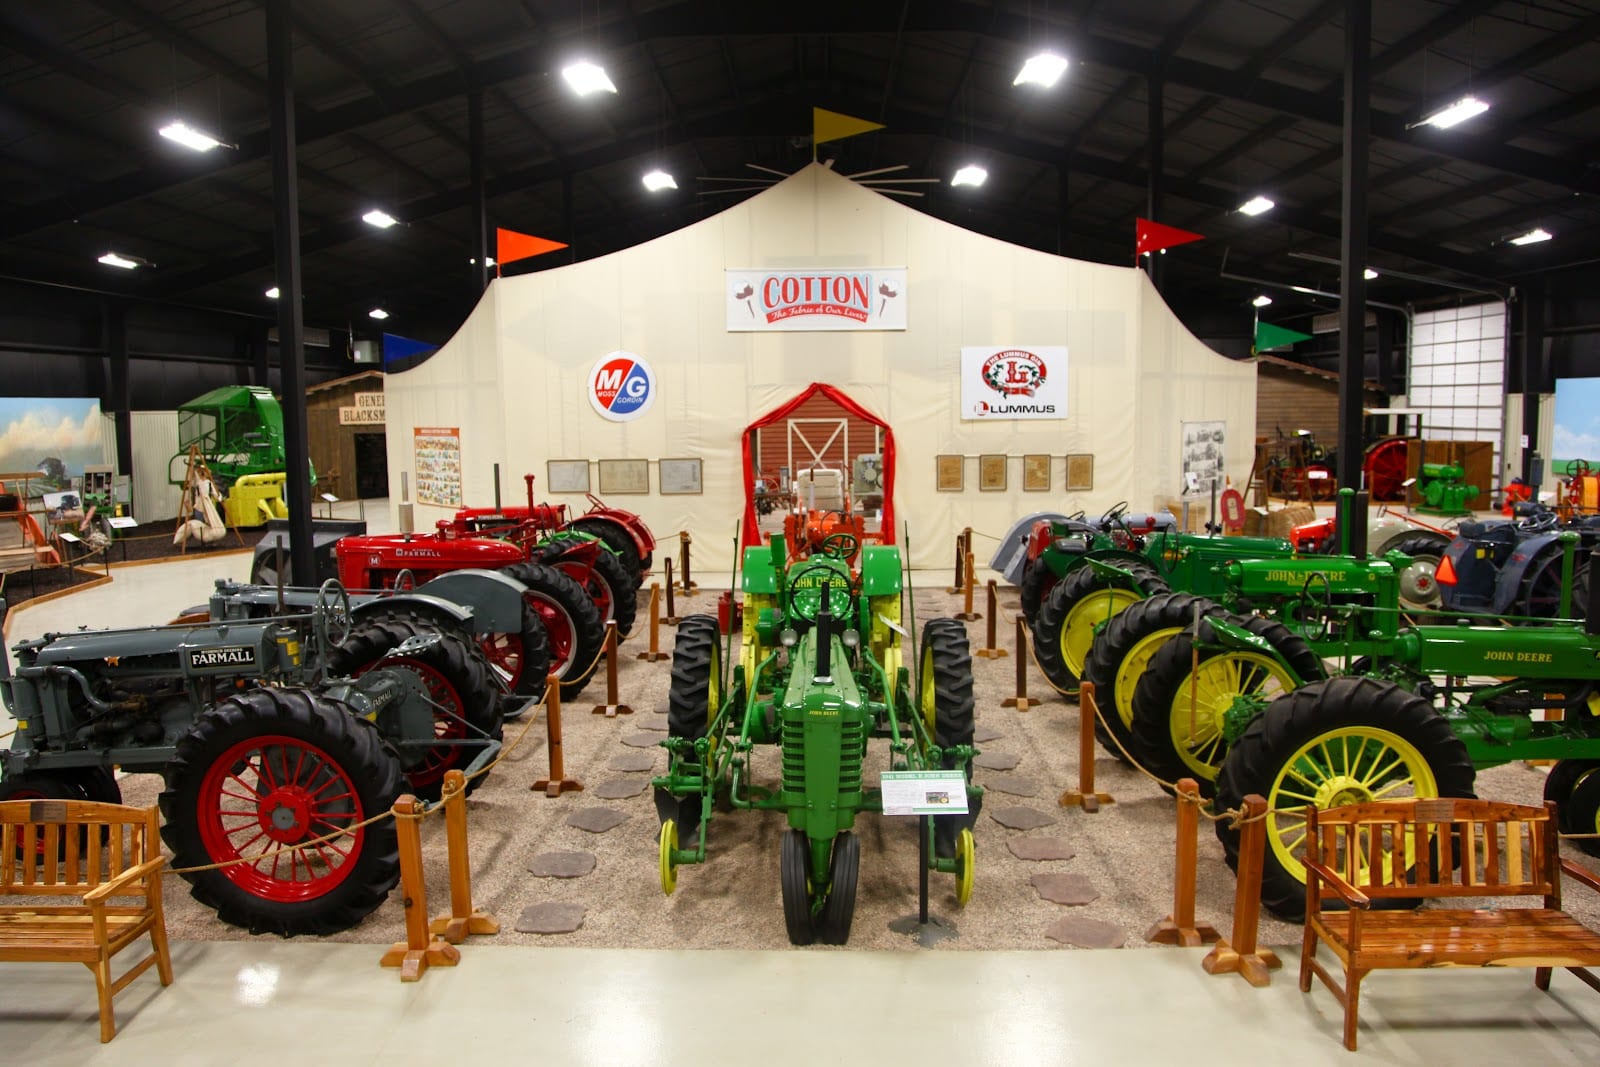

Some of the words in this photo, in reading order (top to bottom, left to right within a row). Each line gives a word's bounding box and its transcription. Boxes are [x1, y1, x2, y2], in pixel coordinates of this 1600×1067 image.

[763, 276, 869, 309] COTTON
[771, 310, 786, 320] The
[788, 304, 814, 315] Fabric
[815, 303, 824, 313] of
[825, 305, 842, 314] Our
[986, 355, 1000, 367] THE
[1000, 351, 1030, 359] LUMMUS
[990, 405, 1055, 413] LUMMUS
[371, 557, 378, 565] M
[1265, 571, 1295, 581] JOHN
[192, 652, 253, 665] FARMALL
[1484, 652, 1514, 660] JOHN
[1517, 653, 1552, 662] DEERE
